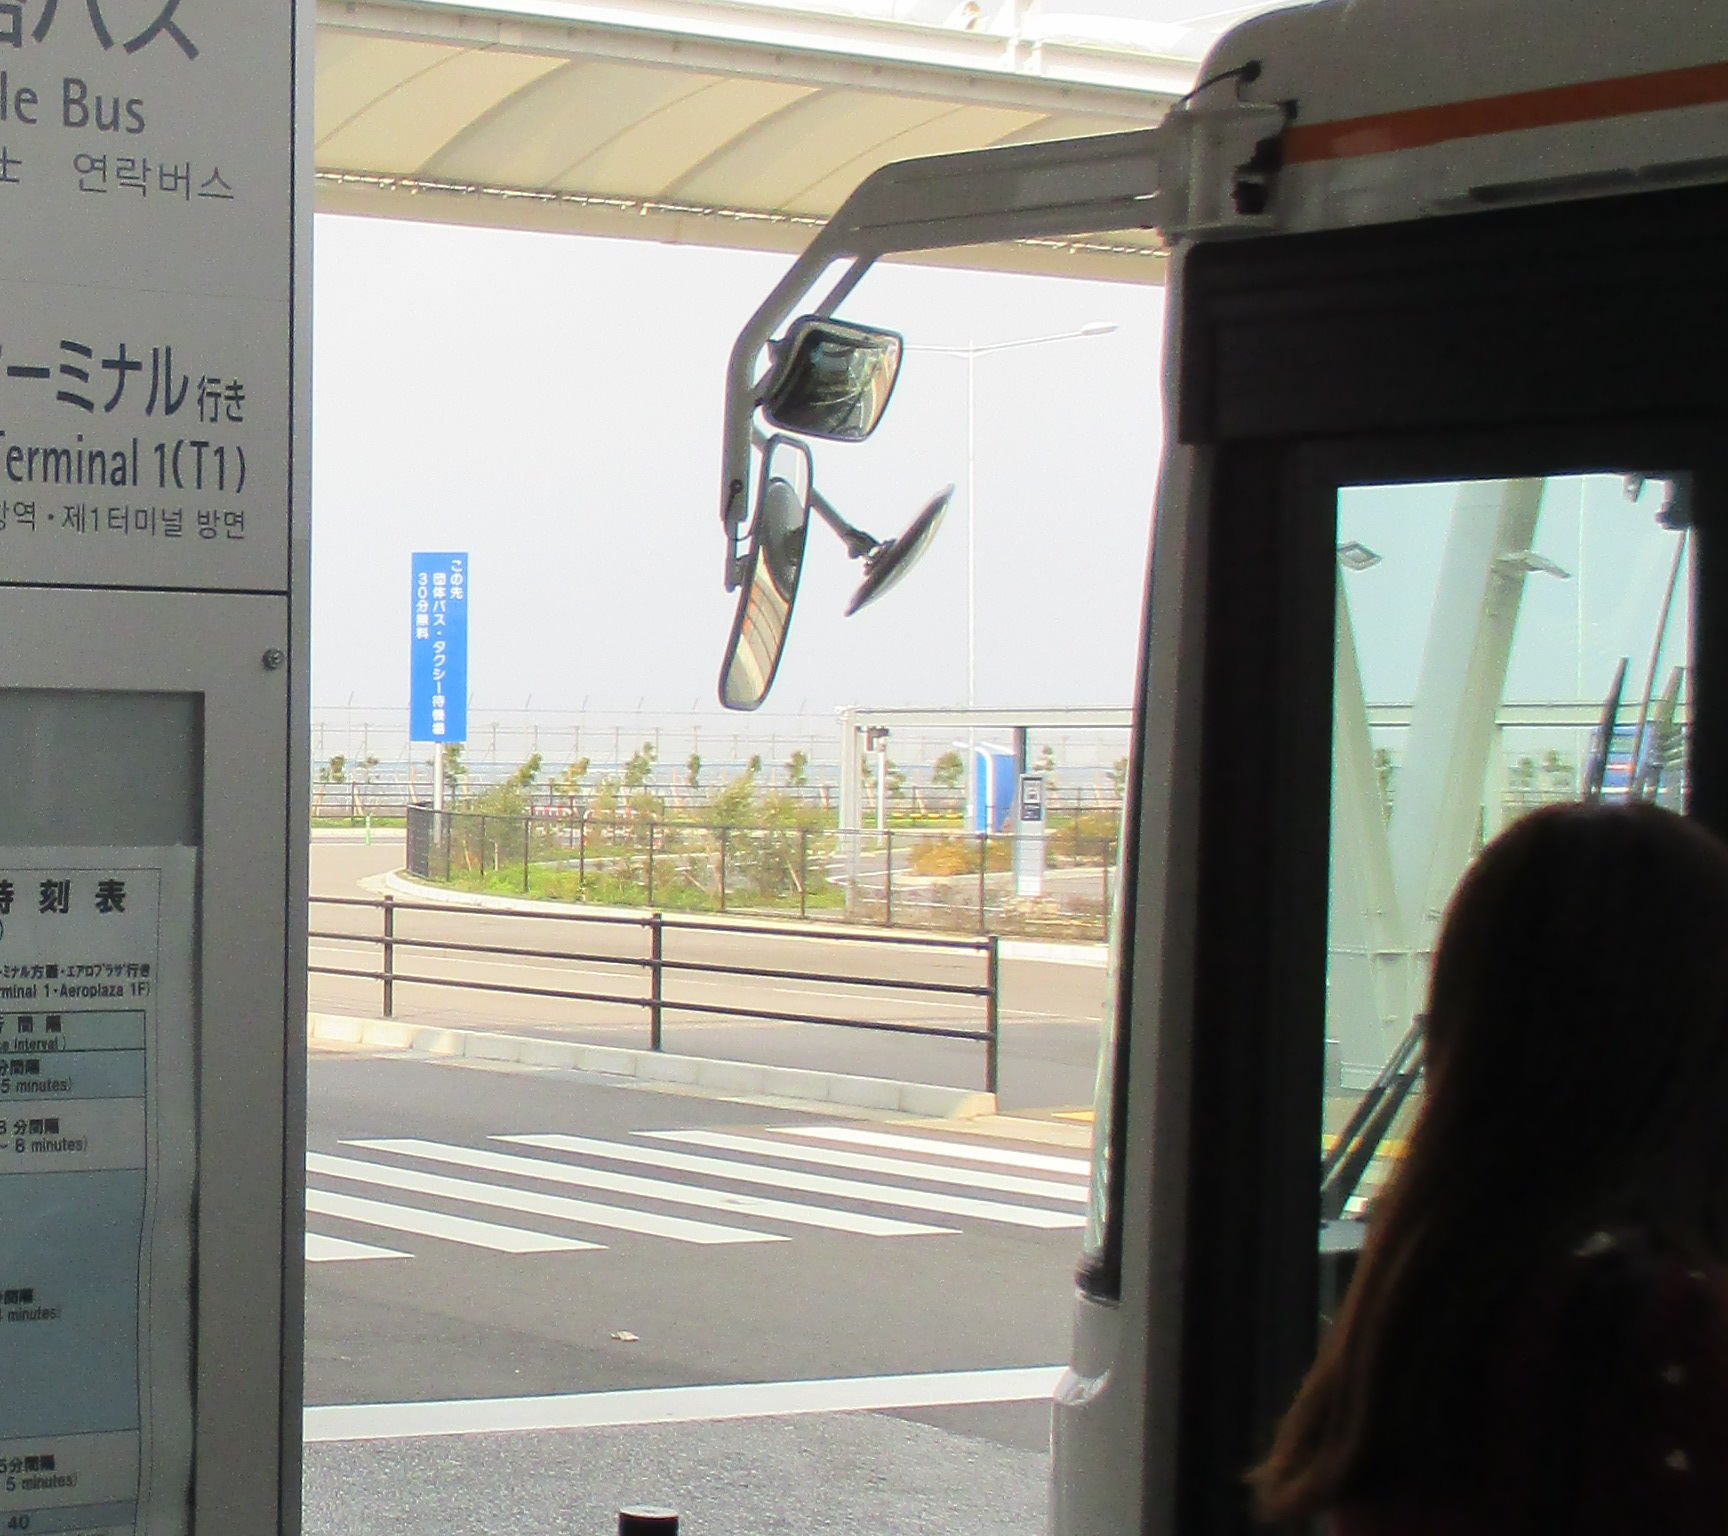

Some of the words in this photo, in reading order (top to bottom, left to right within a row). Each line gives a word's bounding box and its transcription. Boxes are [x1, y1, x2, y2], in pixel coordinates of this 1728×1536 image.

[63, 77, 145, 134] Bus
[73, 153, 234, 201] 연락버스
[197, 510, 245, 540] 방면
[450, 559, 464, 600] この先
[1, 1078, 10, 1093] 5
[6, 1476, 16, 1492] 5
[7, 1514, 30, 1530] 40
